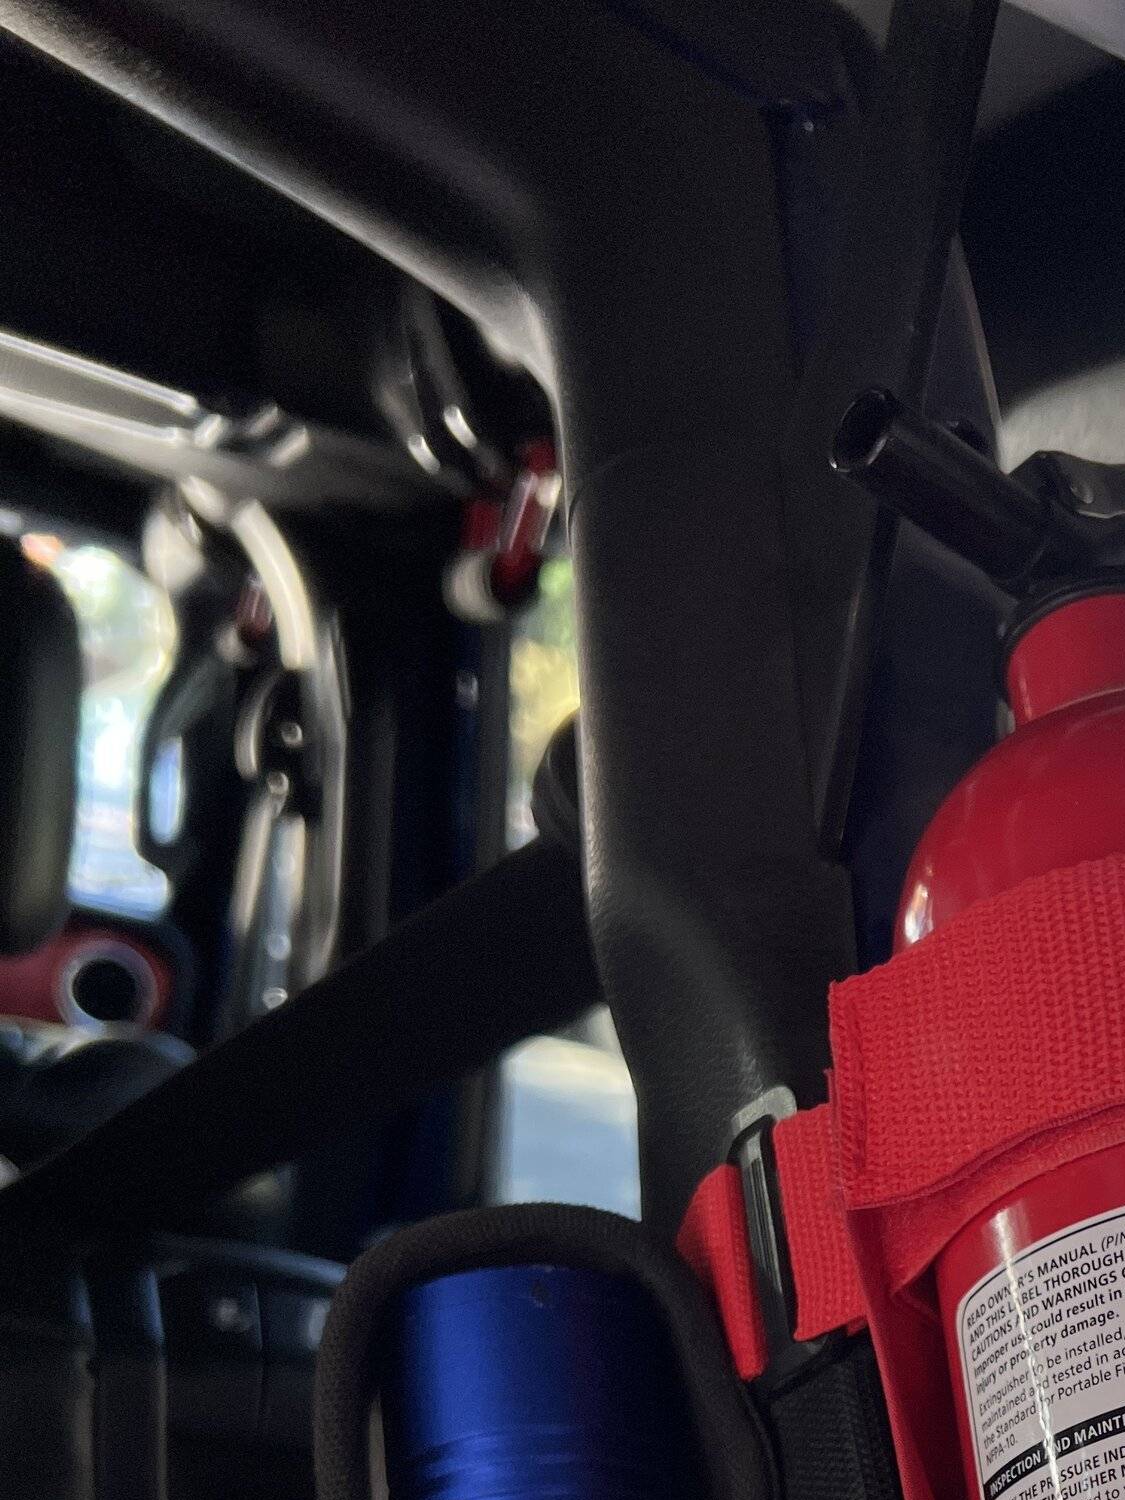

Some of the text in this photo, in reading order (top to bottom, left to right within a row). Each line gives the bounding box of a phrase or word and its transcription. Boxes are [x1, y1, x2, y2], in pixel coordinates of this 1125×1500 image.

[967, 1301, 987, 1329] READ
[1037, 1242, 1098, 1277] MANUAL
[971, 1320, 1013, 1361] CAUTIONS
[1041, 1272, 1118, 1310] WARNINGS
[969, 1320, 986, 1346] AND
[987, 1306, 1008, 1331] THIS
[974, 1341, 1009, 1377] Improper
[1031, 1309, 1063, 1336] could
[1066, 1294, 1106, 1318] result
[1108, 1288, 1123, 1301] in
[998, 1361, 1009, 1375] or
[1060, 1310, 1120, 1339] damage.
[979, 1370, 1030, 1417] Extinguisher
[1046, 1353, 1062, 1370] be
[981, 1391, 1027, 1432] maintained
[1052, 1358, 1092, 1384] tested
[1096, 1352, 1109, 1367] in
[983, 1435, 995, 1450] the
[995, 1400, 1037, 1437] Standard
[1057, 1369, 1112, 1400] Portable
[989, 1450, 1041, 1497] INSPECTION
[1105, 1488, 1120, 1500] to
